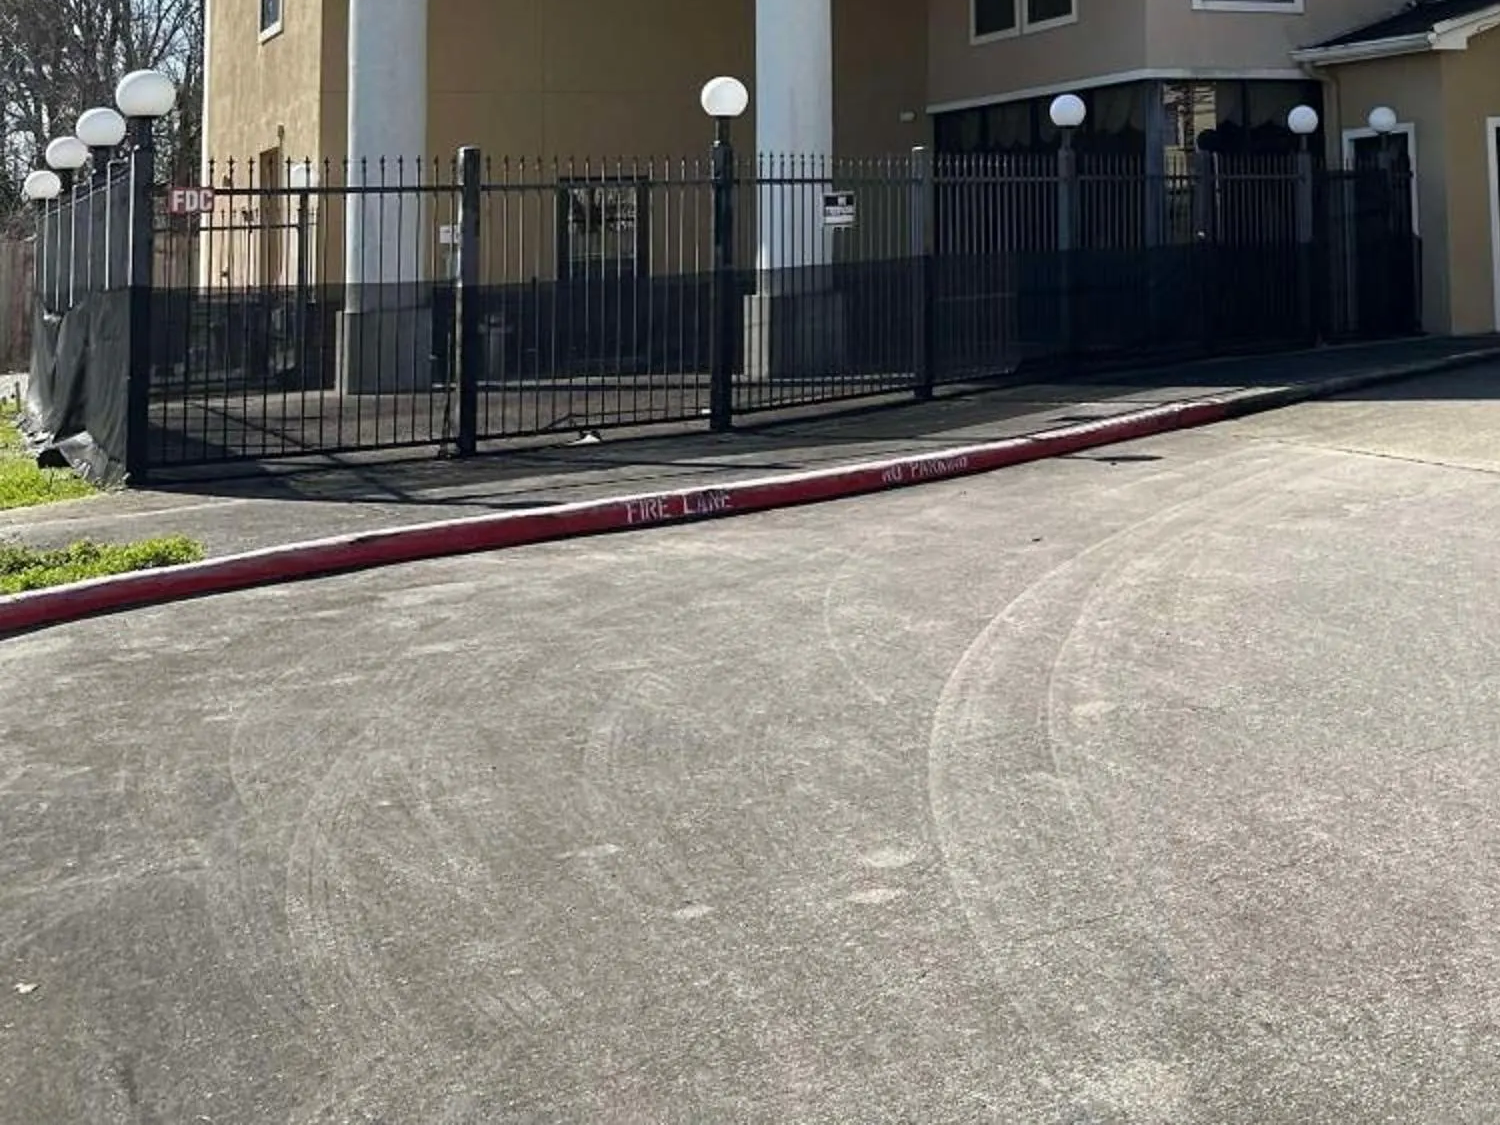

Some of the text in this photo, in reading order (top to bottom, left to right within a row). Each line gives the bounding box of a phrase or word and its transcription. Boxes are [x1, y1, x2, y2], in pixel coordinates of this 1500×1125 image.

[172, 190, 213, 212] FDC
[625, 492, 733, 523] FIRE LANE
